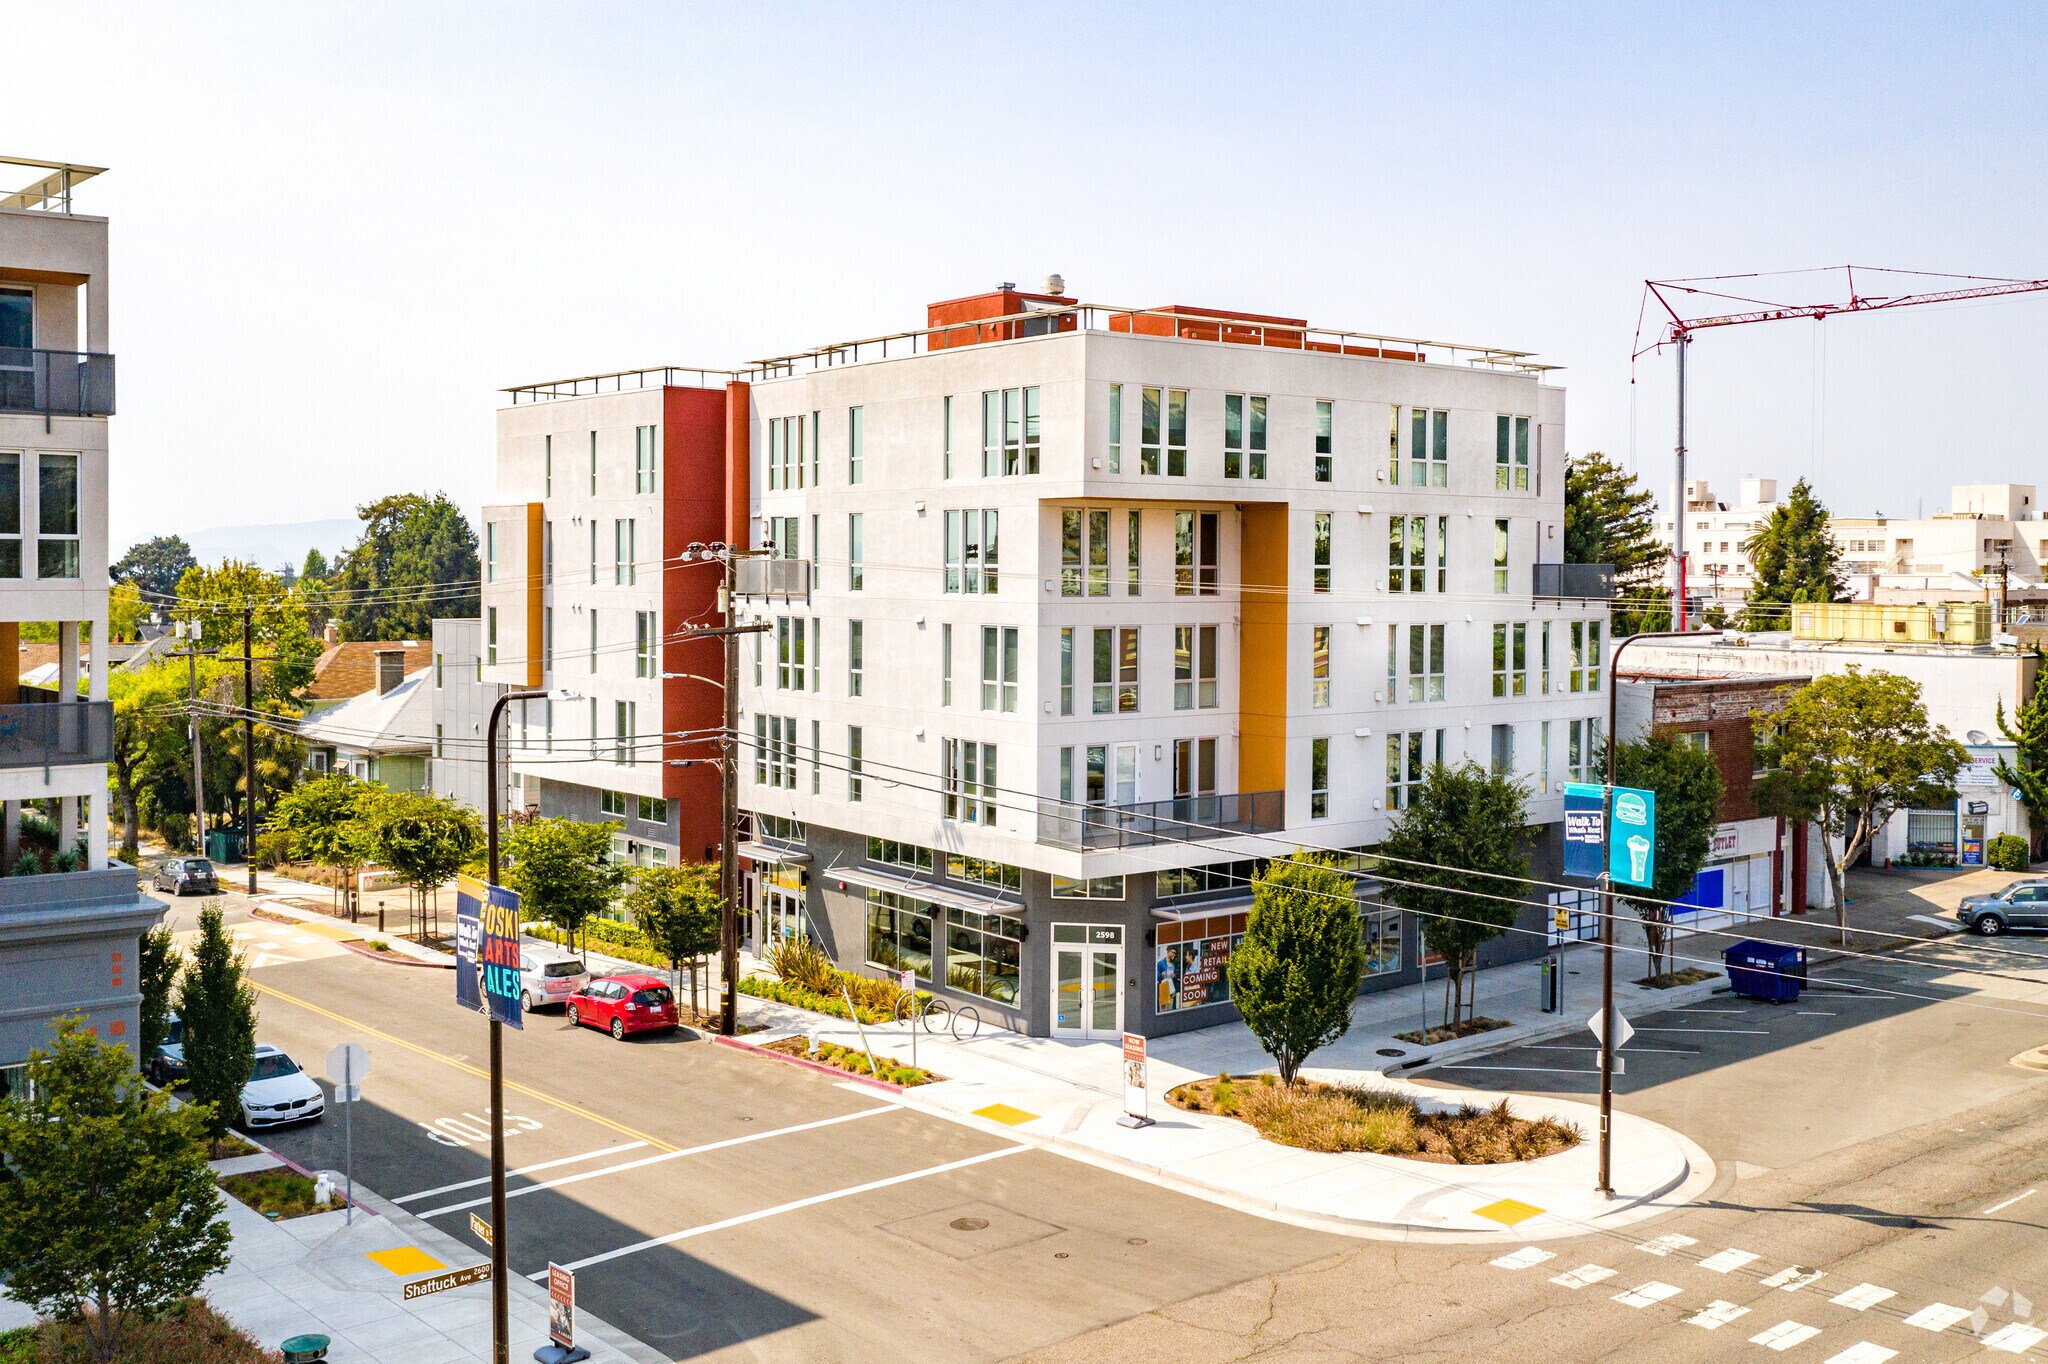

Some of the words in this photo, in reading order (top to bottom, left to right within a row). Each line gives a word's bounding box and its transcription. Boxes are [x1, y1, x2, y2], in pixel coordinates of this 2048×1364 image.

[1568, 816, 1590, 826] Walk
[1591, 816, 1601, 826] To
[485, 904, 519, 941] OSKI
[1095, 931, 1115, 939] 2598
[1211, 941, 1228, 951] NEW
[484, 937, 520, 969] ARTS
[1203, 955, 1229, 967] RETAIL
[486, 964, 520, 1001] ALES
[1183, 971, 1218, 985] COMING
[1183, 989, 1207, 1001] SOON
[1128, 1037, 1140, 1045] NOW
[1124, 1043, 1144, 1053] LEASING
[405, 1274, 457, 1298] Shattuck
[459, 1273, 472, 1282] Ave
[473, 1265, 490, 1275] 2600
[552, 1268, 570, 1283] LEASING
[553, 1277, 569, 1291] OFFICE
